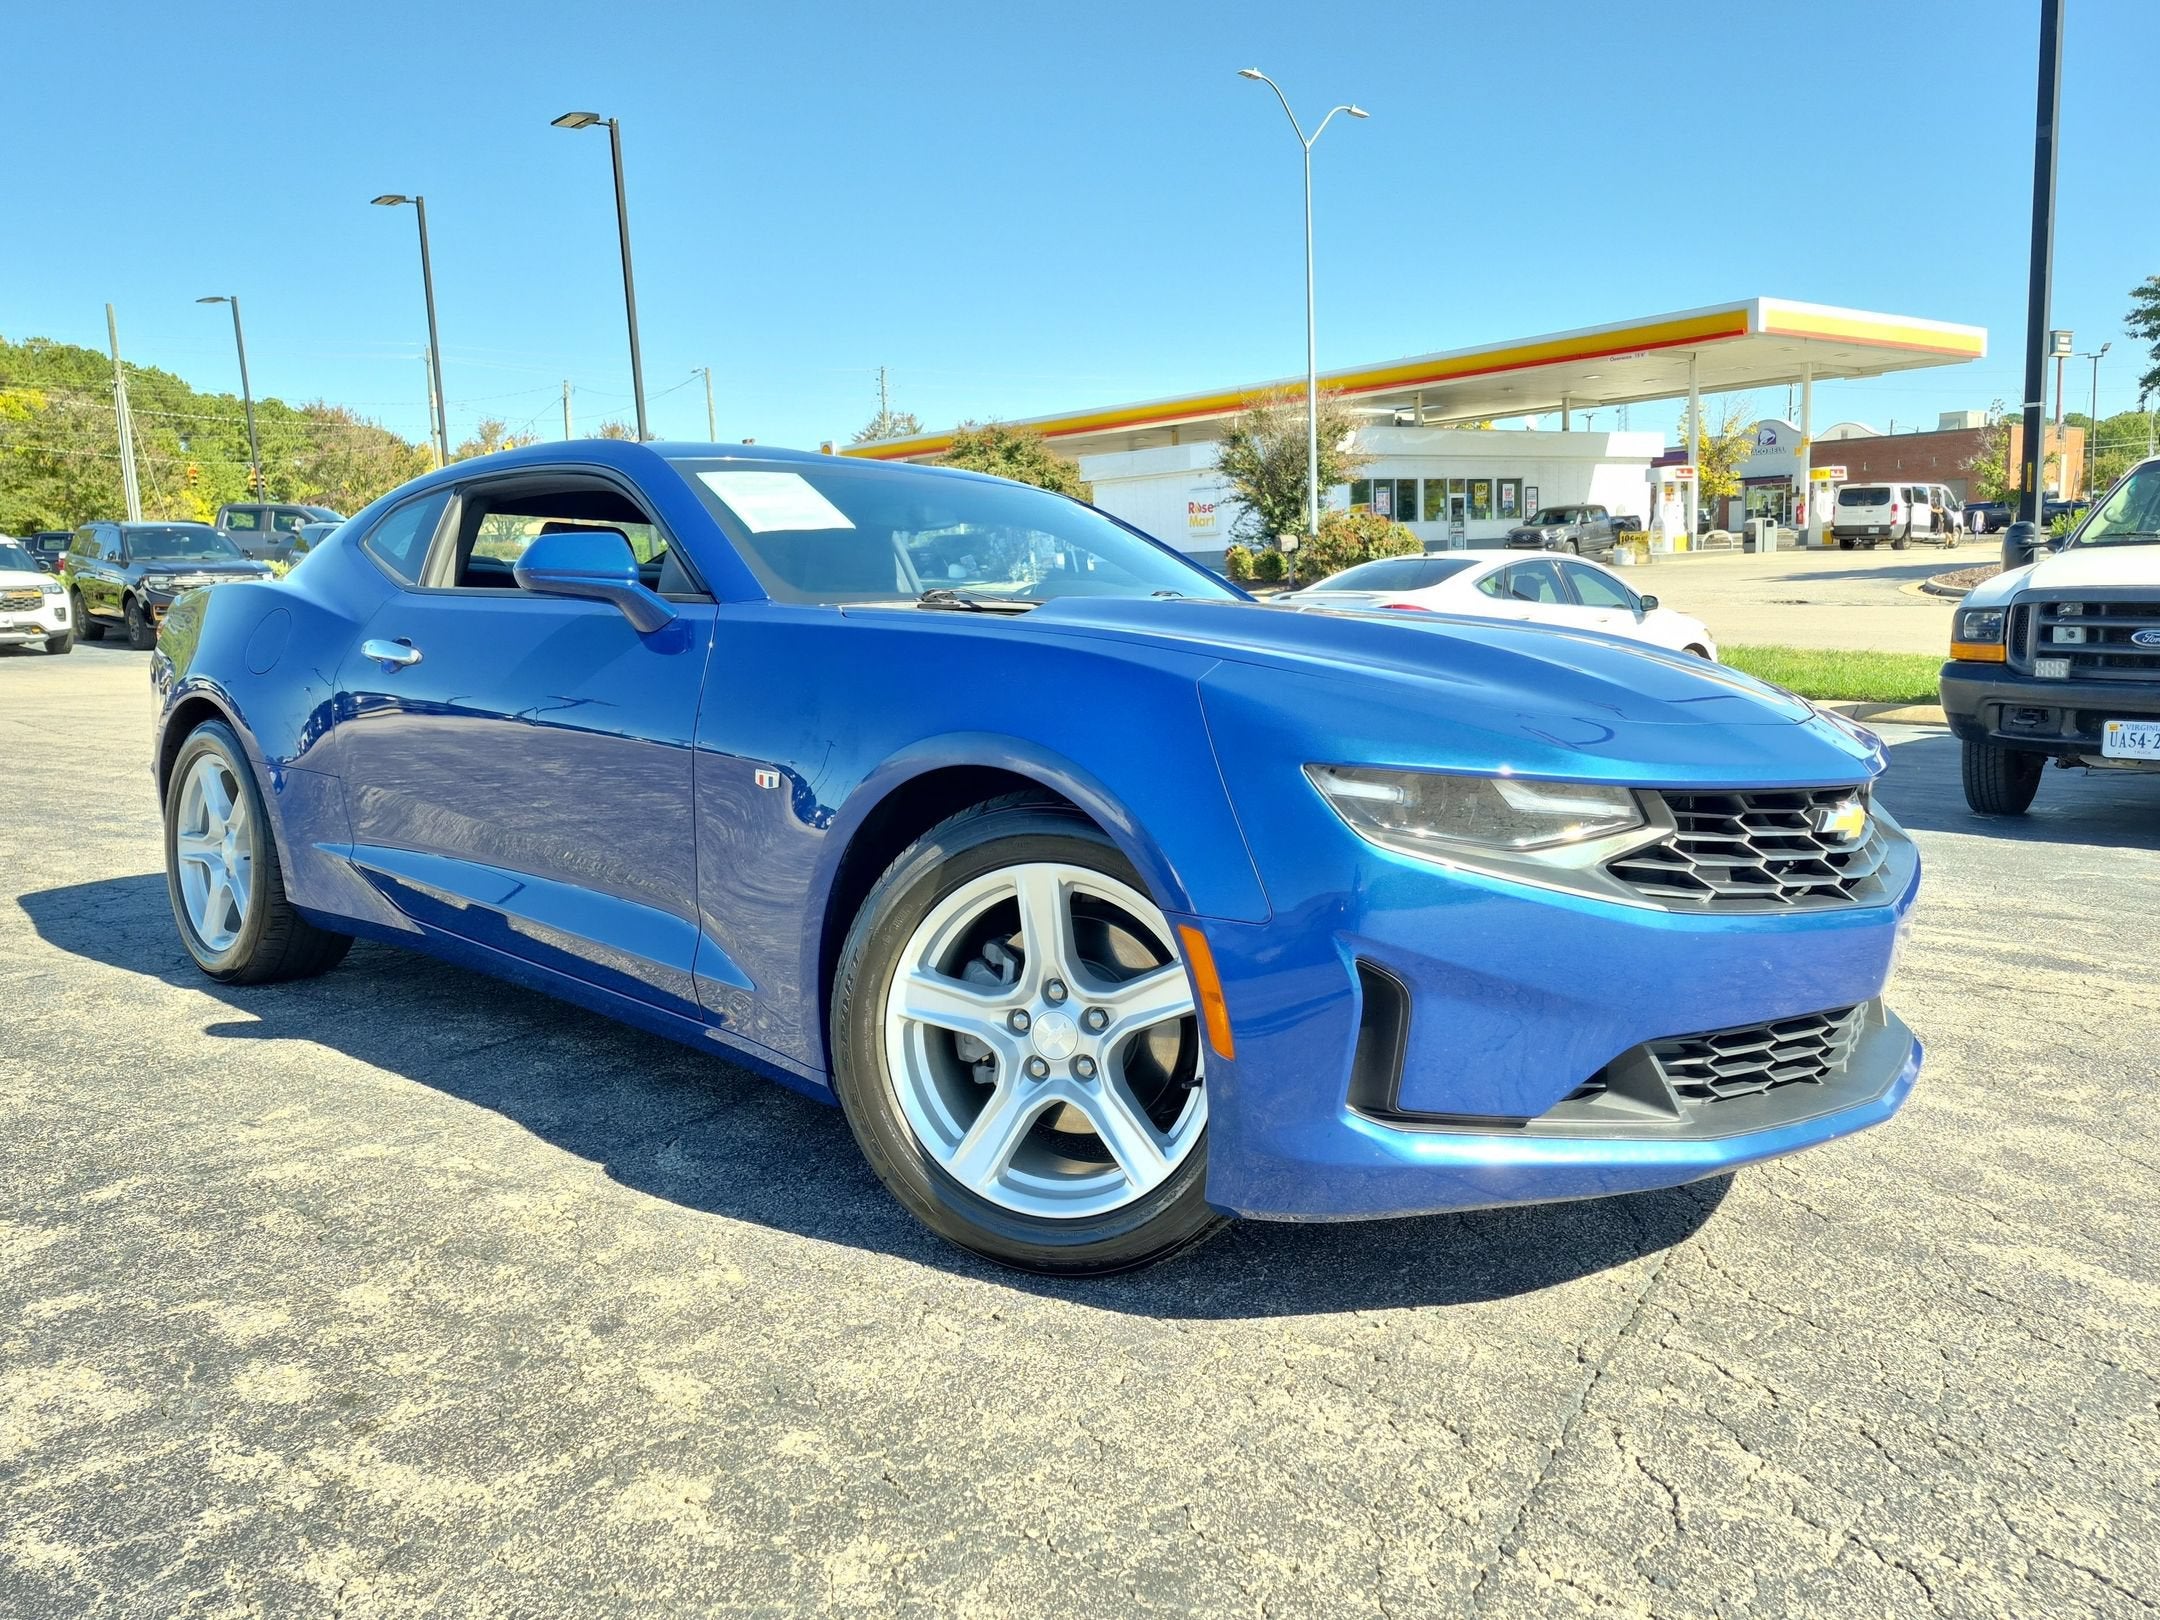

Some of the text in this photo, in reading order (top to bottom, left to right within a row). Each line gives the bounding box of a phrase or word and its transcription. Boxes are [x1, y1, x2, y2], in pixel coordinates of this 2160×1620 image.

[1188, 501, 1214, 514] Rose
[1189, 515, 1215, 528] Mart
[2126, 723, 2160, 732] VIRGINI
[2110, 731, 2160, 749] UA54-2
